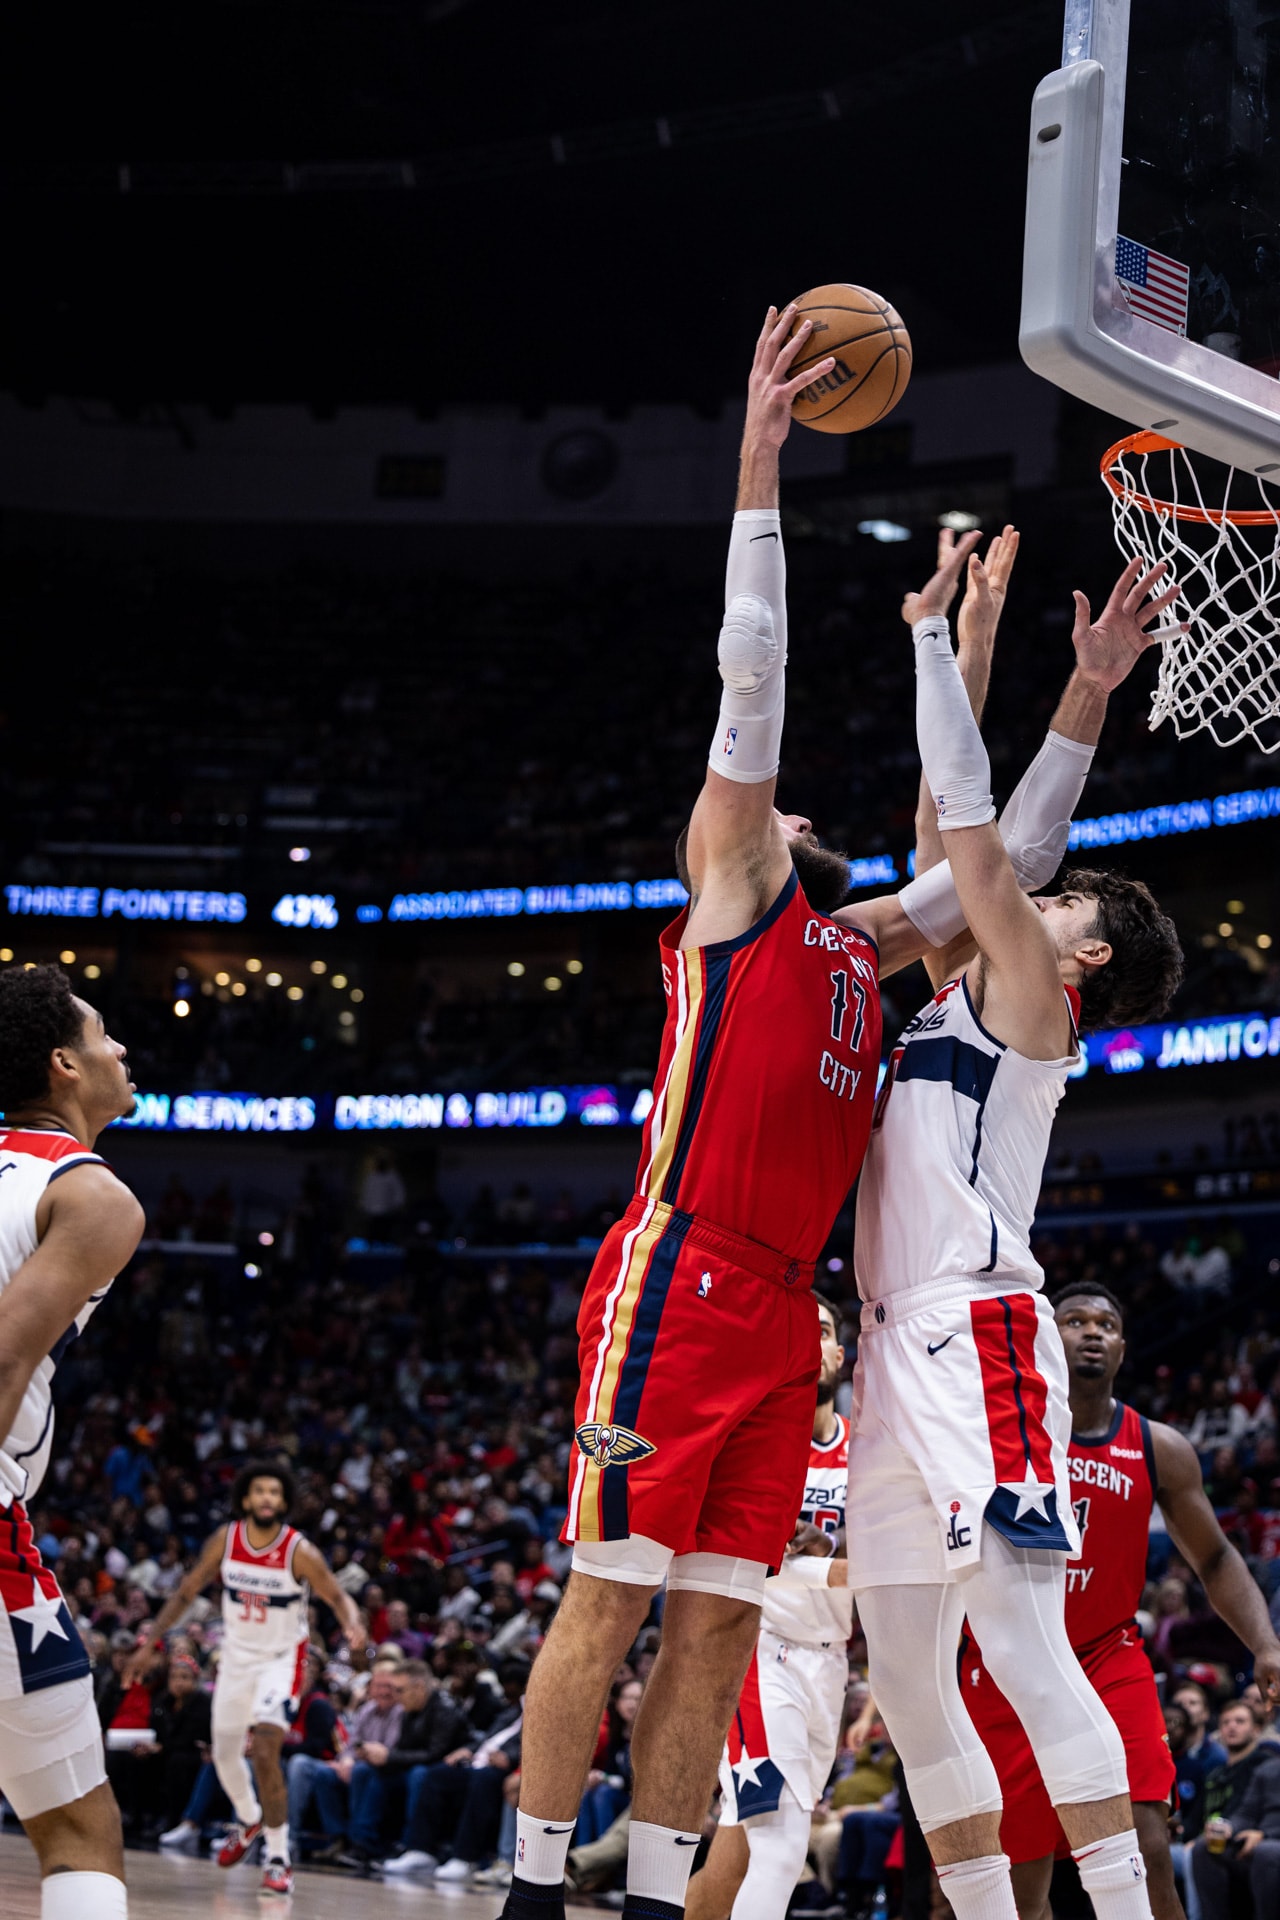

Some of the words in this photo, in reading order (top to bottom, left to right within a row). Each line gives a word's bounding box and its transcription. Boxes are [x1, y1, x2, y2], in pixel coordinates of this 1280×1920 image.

[1213, 787, 1280, 827] SERVI
[4, 885, 99, 917] THREE
[102, 888, 247, 922] POINTERS
[830, 968, 866, 1053] 17
[819, 1050, 862, 1101] CITY
[174, 1095, 316, 1130] SERVICES
[334, 1095, 444, 1129] DESIGN
[446, 1093, 472, 1127] &
[475, 1091, 567, 1127] BUILD
[1066, 1457, 1134, 1501] SCENT
[1066, 1567, 1094, 1593] TY
[237, 1591, 269, 1624] 35
